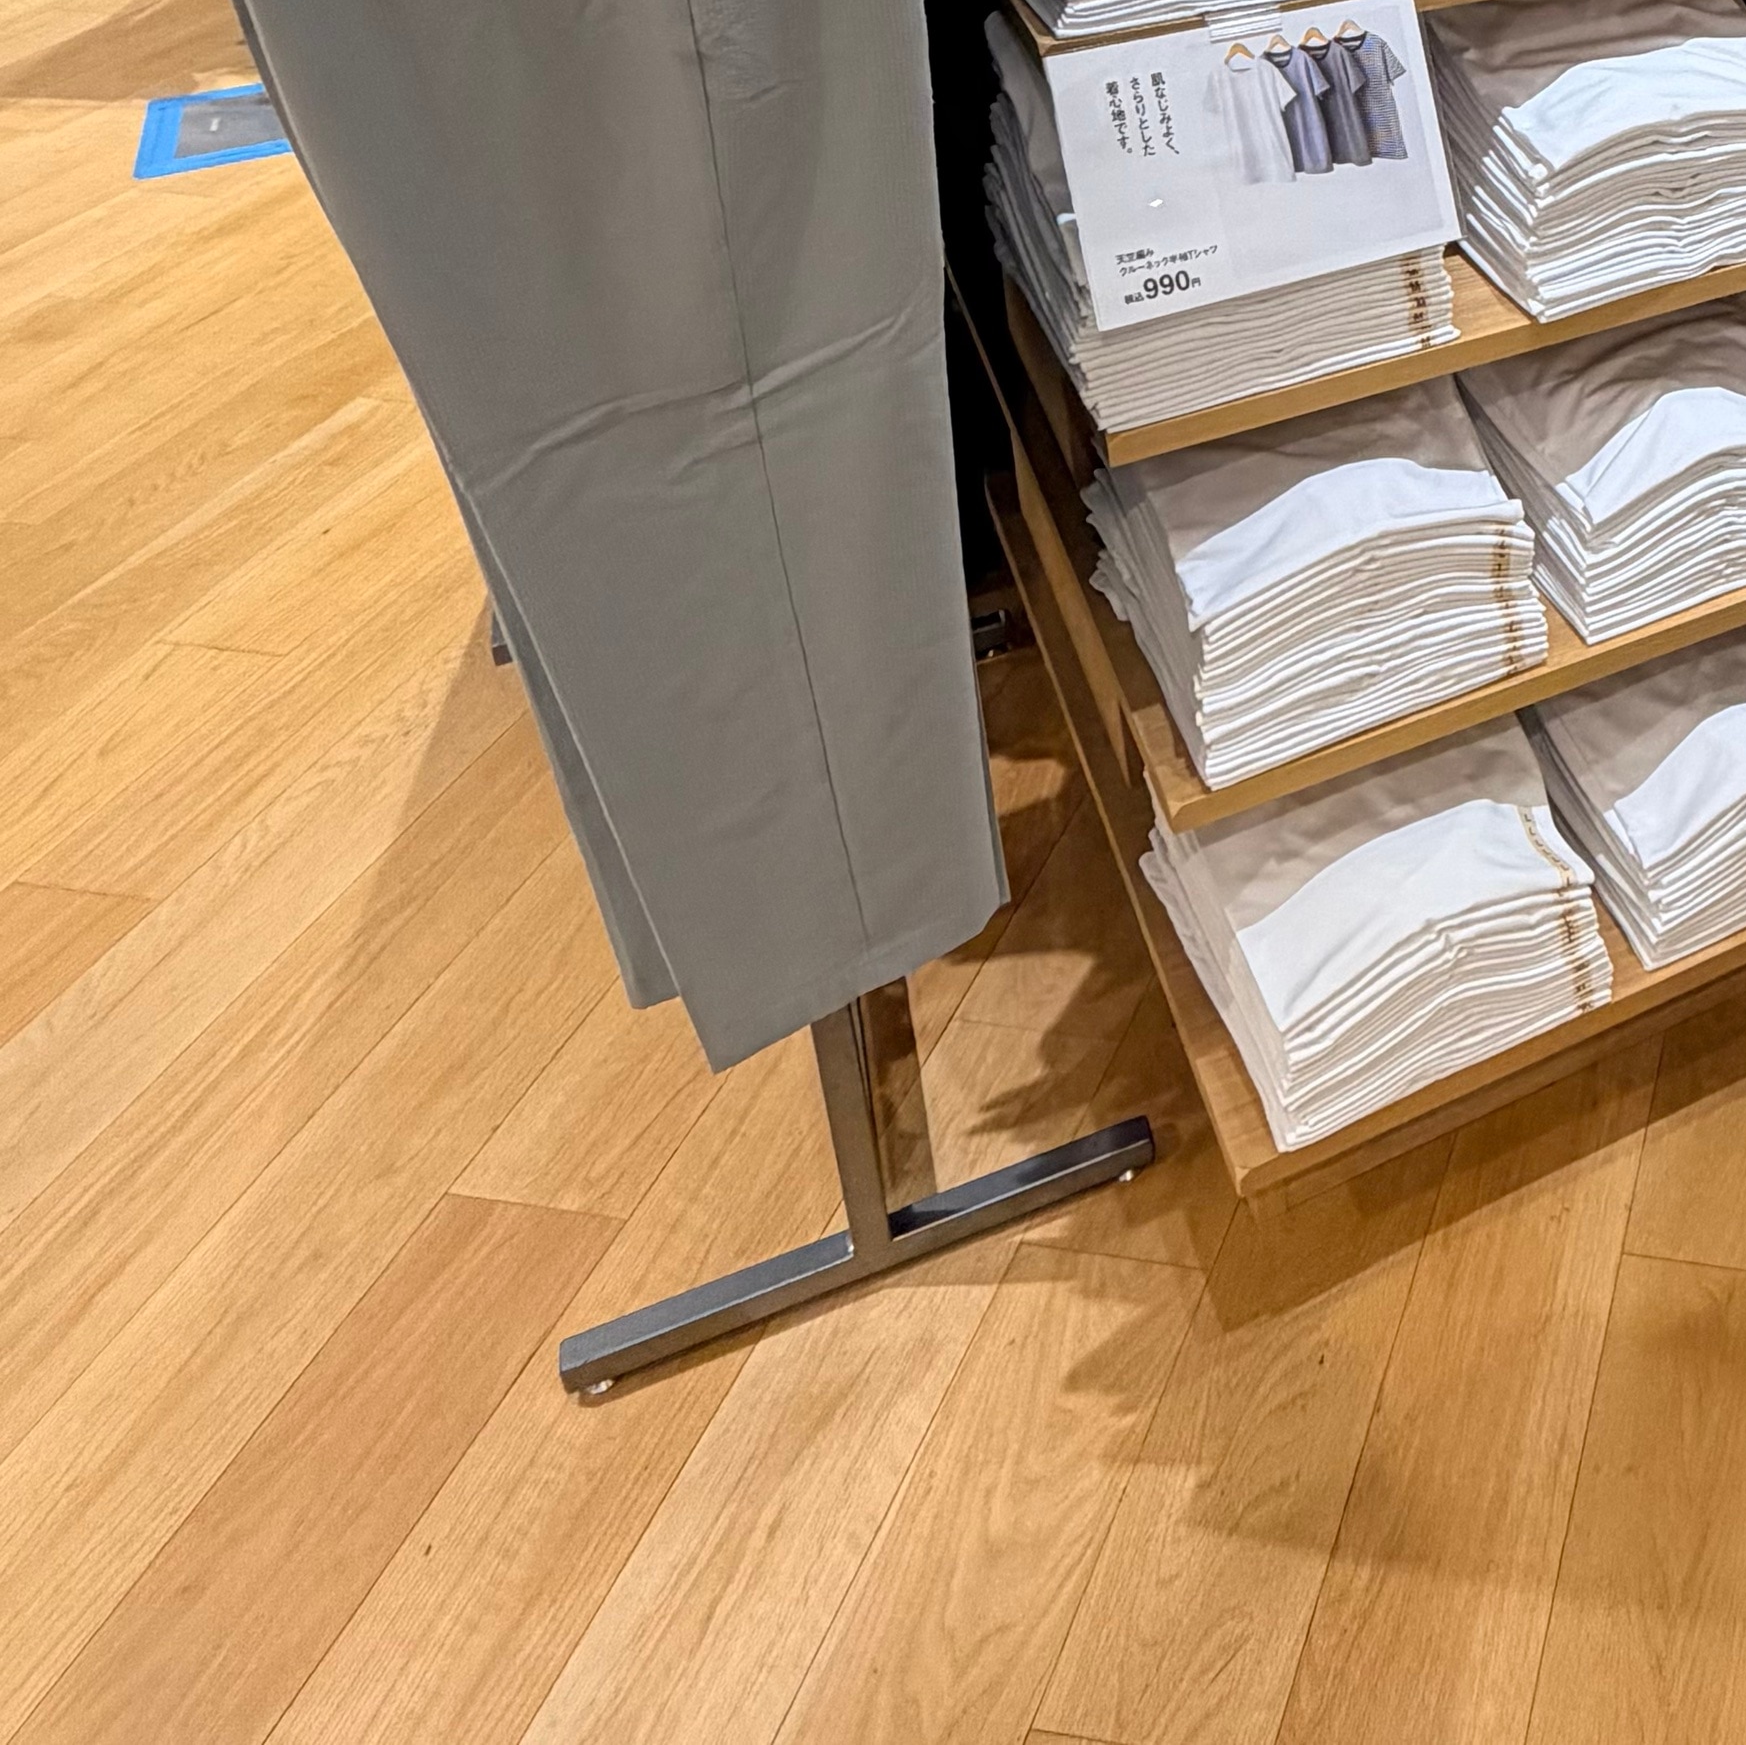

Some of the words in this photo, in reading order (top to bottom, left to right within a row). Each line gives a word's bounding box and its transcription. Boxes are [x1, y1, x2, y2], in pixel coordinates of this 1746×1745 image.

[1105, 80, 1133, 154] 着心地です。
[1129, 76, 1157, 157] さらりとした
[1150, 71, 1181, 155] 肌なじみよく、
[1119, 244, 1218, 277] クルーネック半袖Tシャツ
